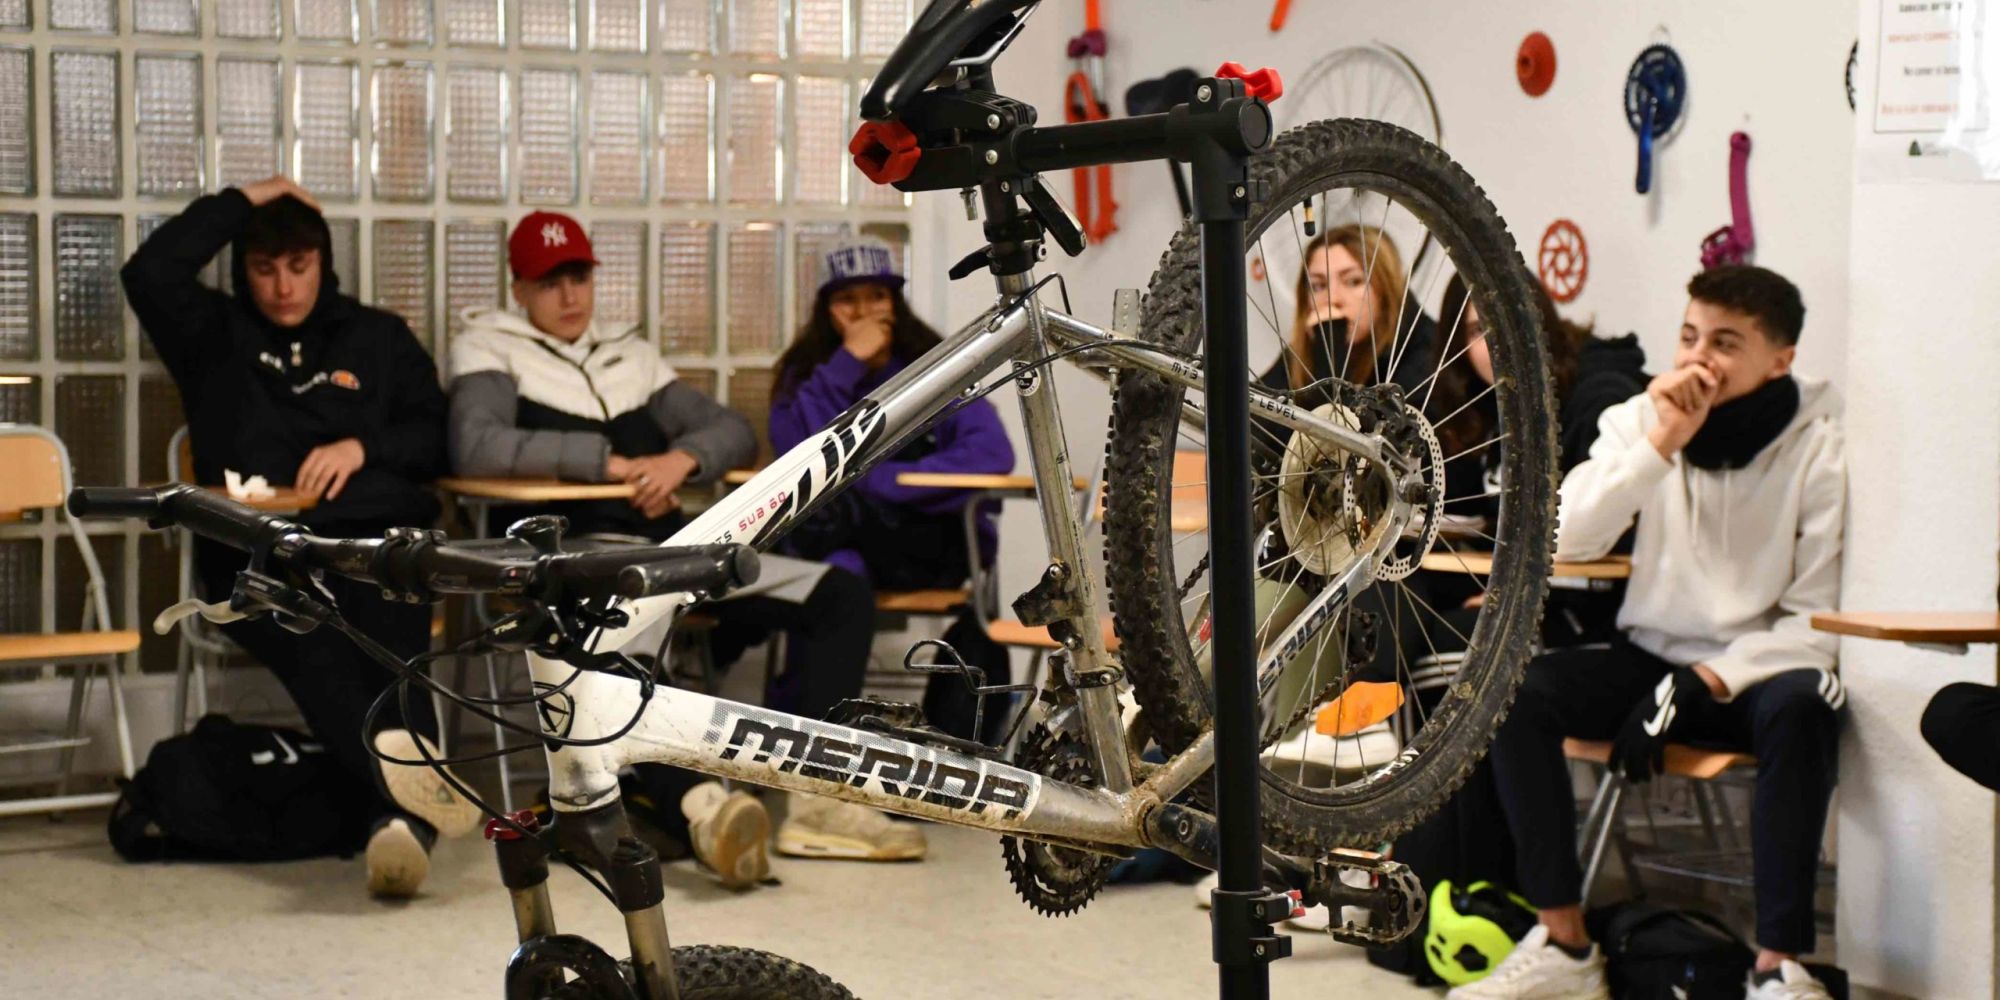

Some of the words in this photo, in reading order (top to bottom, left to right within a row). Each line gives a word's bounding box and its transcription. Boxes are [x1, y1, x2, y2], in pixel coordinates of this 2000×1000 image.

[1259, 397, 1297, 421] LEVEL
[738, 507, 765, 532] SUB
[1257, 582, 1349, 699] ERIDA
[716, 716, 1032, 822] MERIDA
